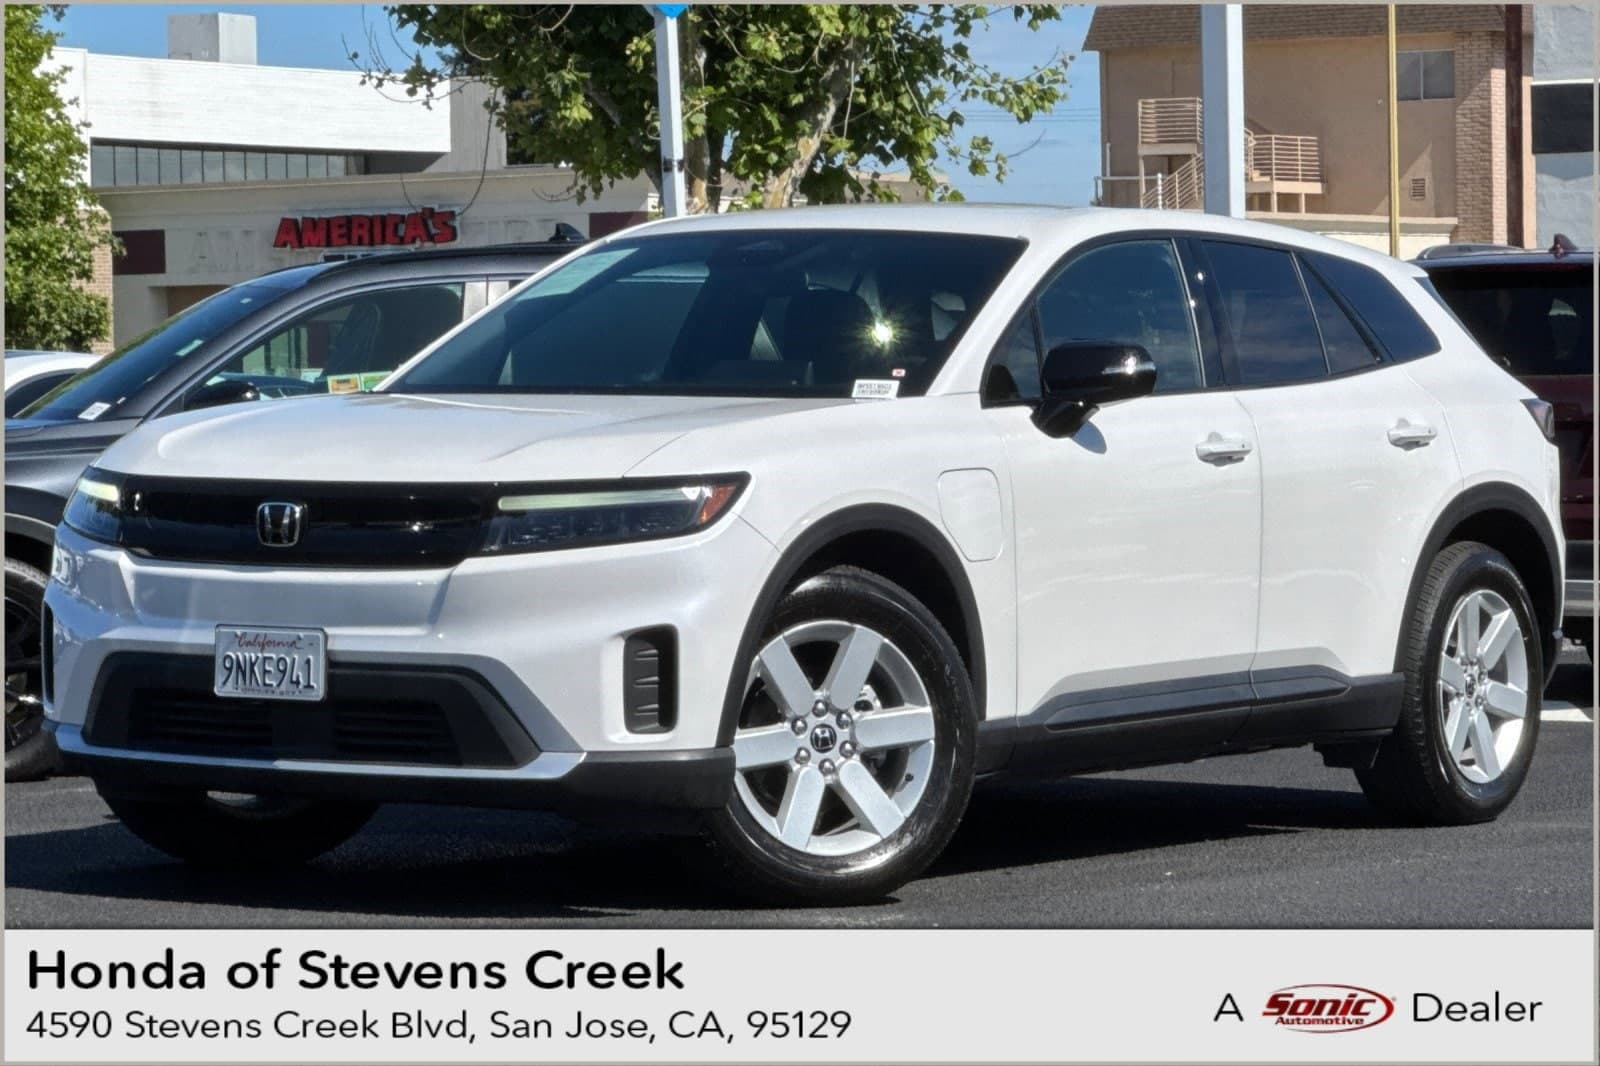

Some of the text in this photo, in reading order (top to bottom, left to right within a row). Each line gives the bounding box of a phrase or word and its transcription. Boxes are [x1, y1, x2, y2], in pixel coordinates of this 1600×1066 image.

[273, 207, 457, 249] AMERICA'S
[236, 632, 304, 651] California
[222, 653, 317, 689] 9NKE941
